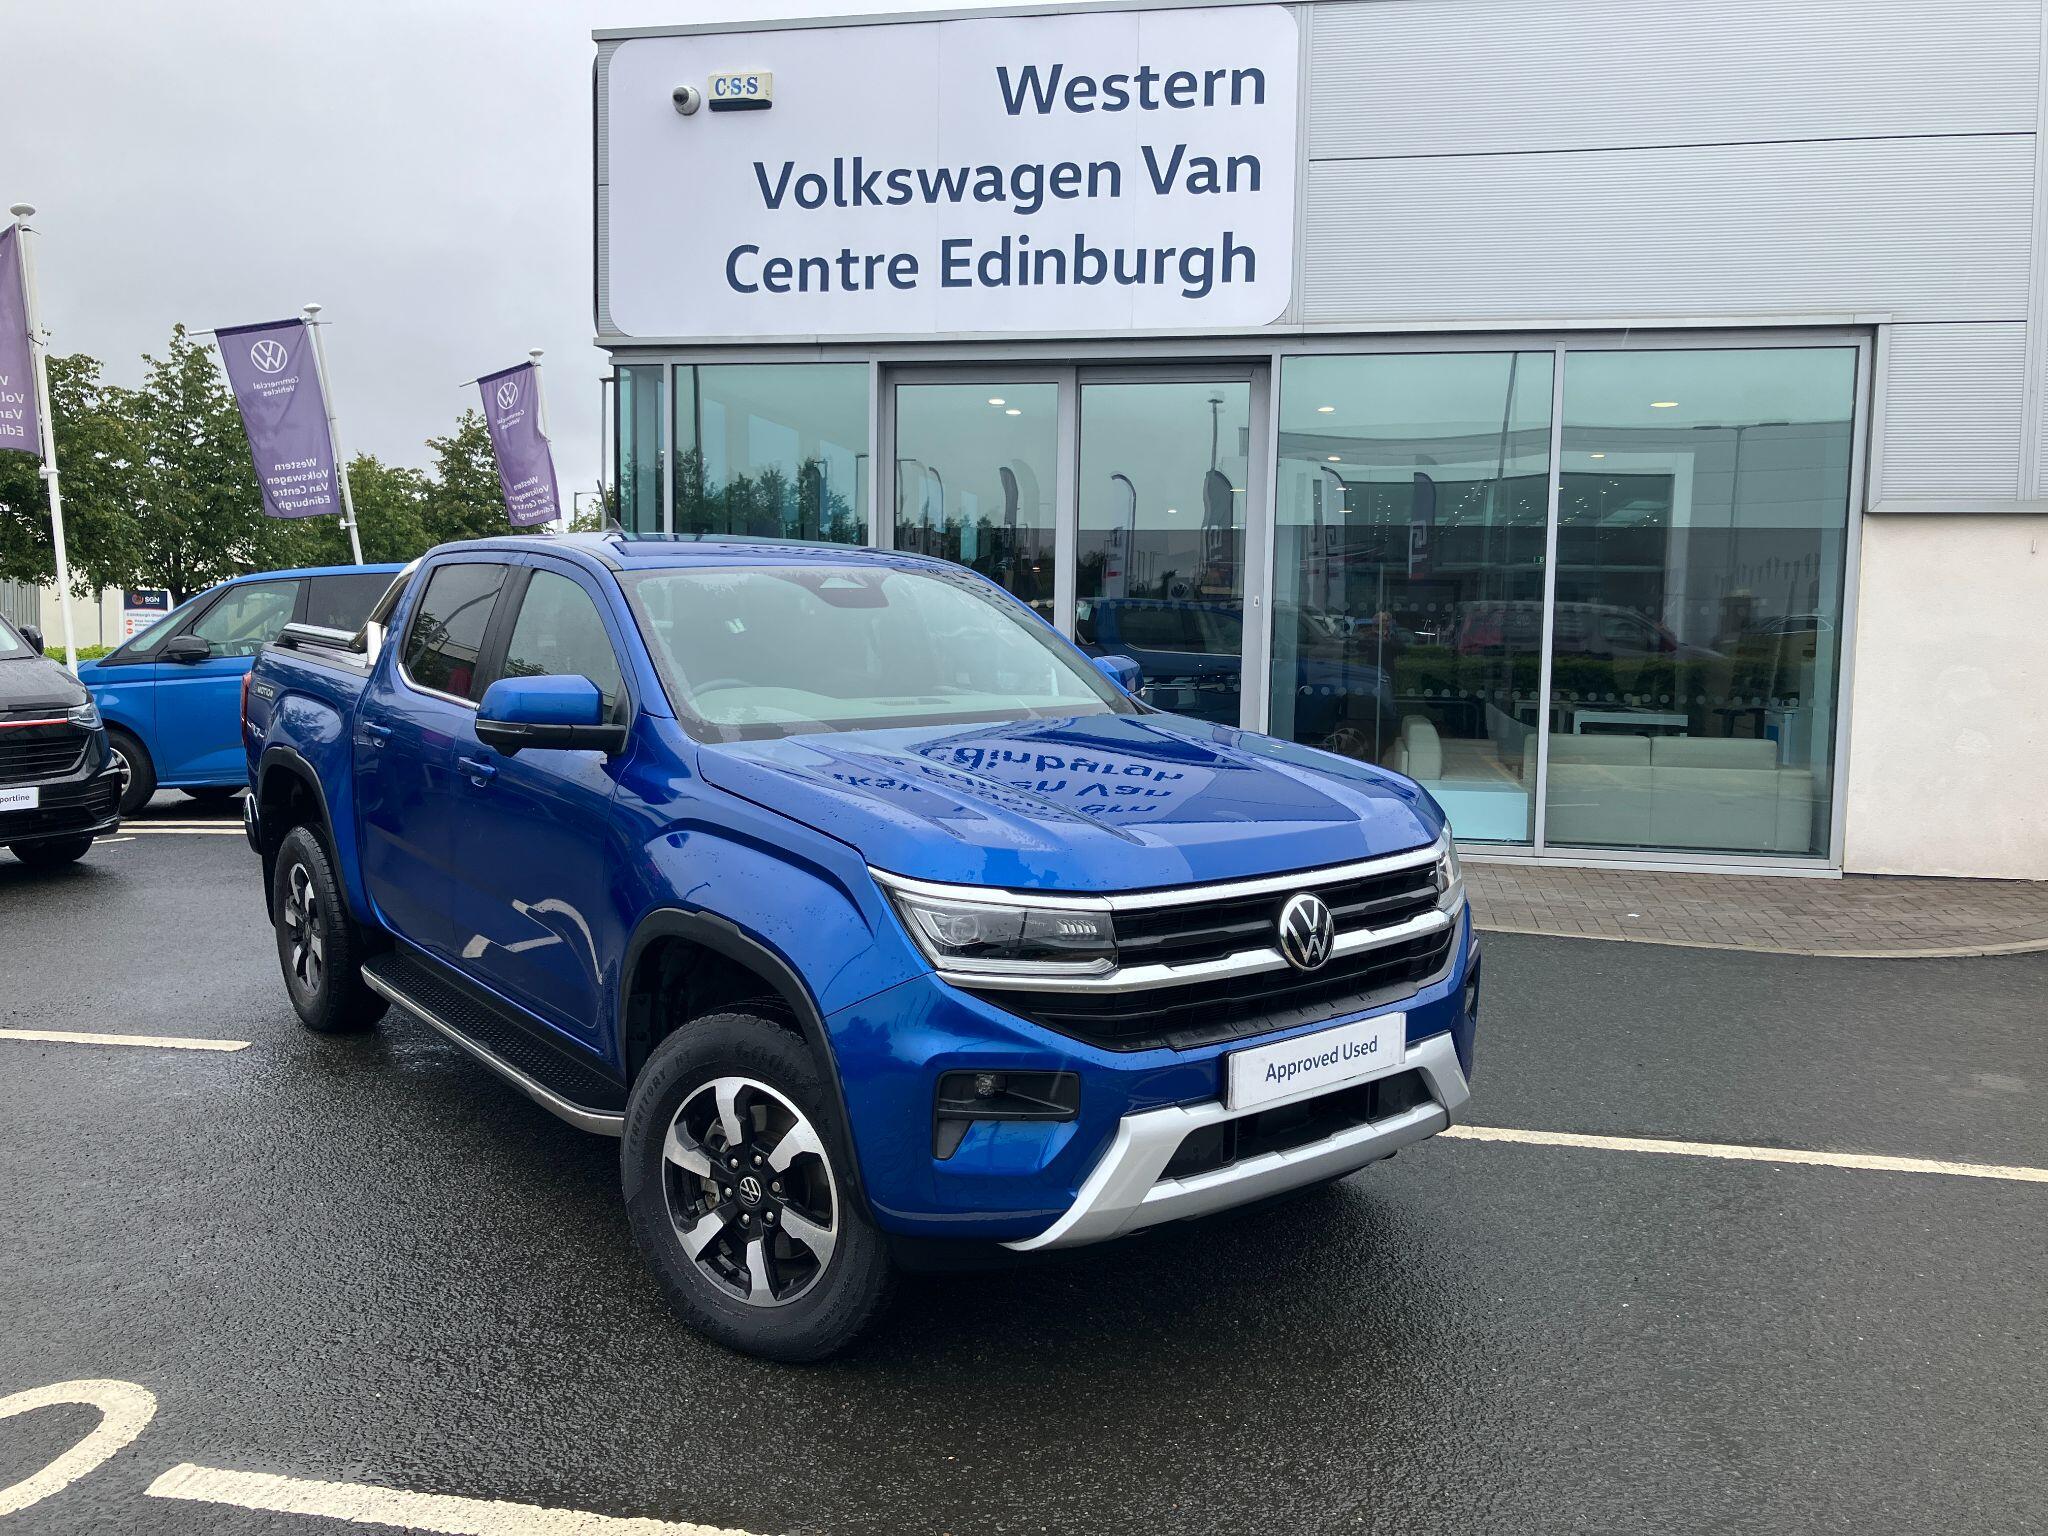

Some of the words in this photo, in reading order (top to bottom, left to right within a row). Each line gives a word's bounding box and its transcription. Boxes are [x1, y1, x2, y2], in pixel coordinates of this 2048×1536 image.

[995, 63, 1265, 116] Western
[752, 156, 1121, 216] Volkswagen
[1140, 143, 1261, 195] Van
[725, 244, 919, 294] Centre
[941, 231, 1256, 299] Edinburgh
[1264, 1045, 1339, 1083] Approved
[1343, 1035, 1378, 1061] Used
